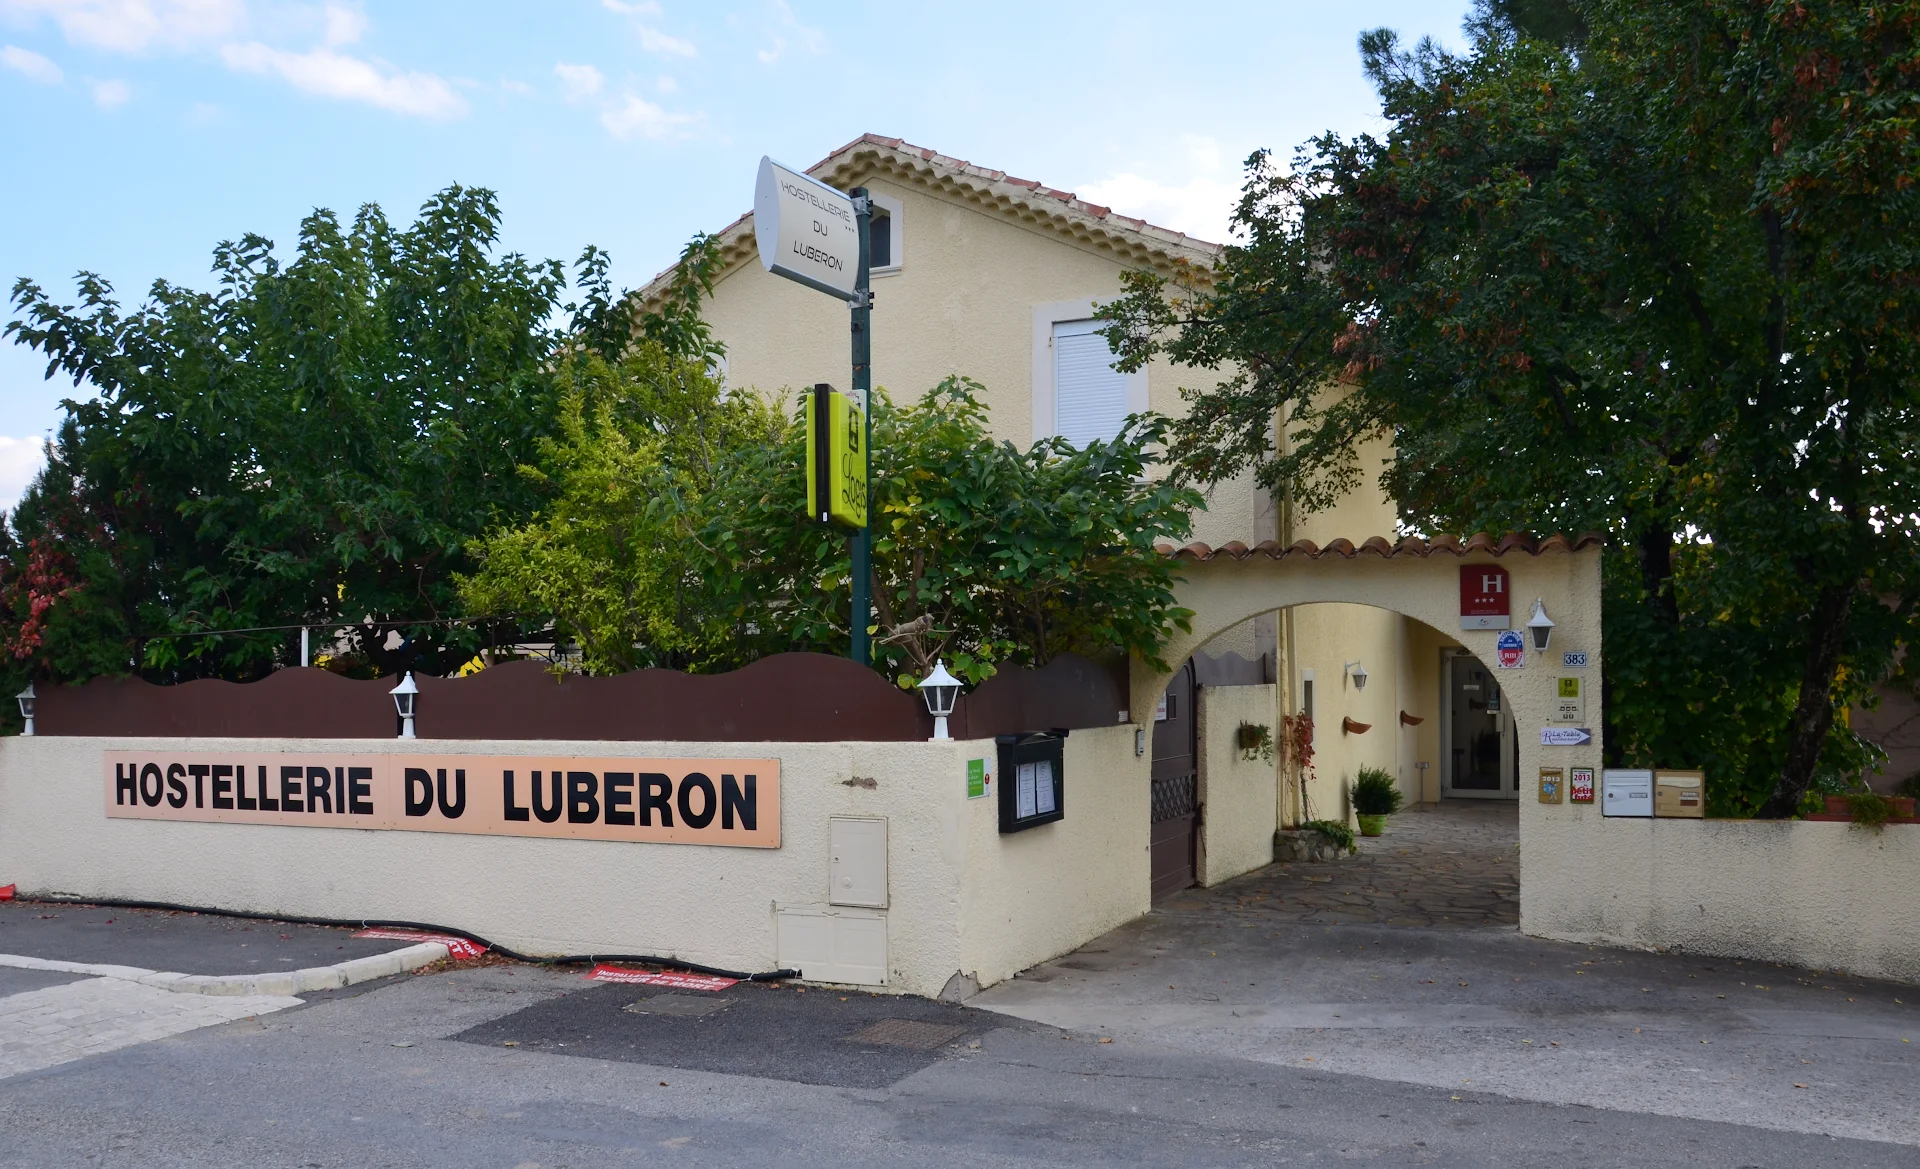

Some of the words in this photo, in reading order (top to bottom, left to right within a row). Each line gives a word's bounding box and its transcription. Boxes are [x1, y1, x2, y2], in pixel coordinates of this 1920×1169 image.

[781, 180, 851, 222] HOSTELLERIE
[813, 220, 828, 236] DU
[793, 240, 843, 272] LUBERON
[1482, 575, 1502, 593] H
[1565, 654, 1585, 664] 383
[116, 763, 374, 815] HOSTELLERIE
[405, 768, 467, 819] DU
[503, 770, 757, 831] LUBERON
[669, 981, 716, 991] MORT
[686, 978, 730, 987] TENSION
